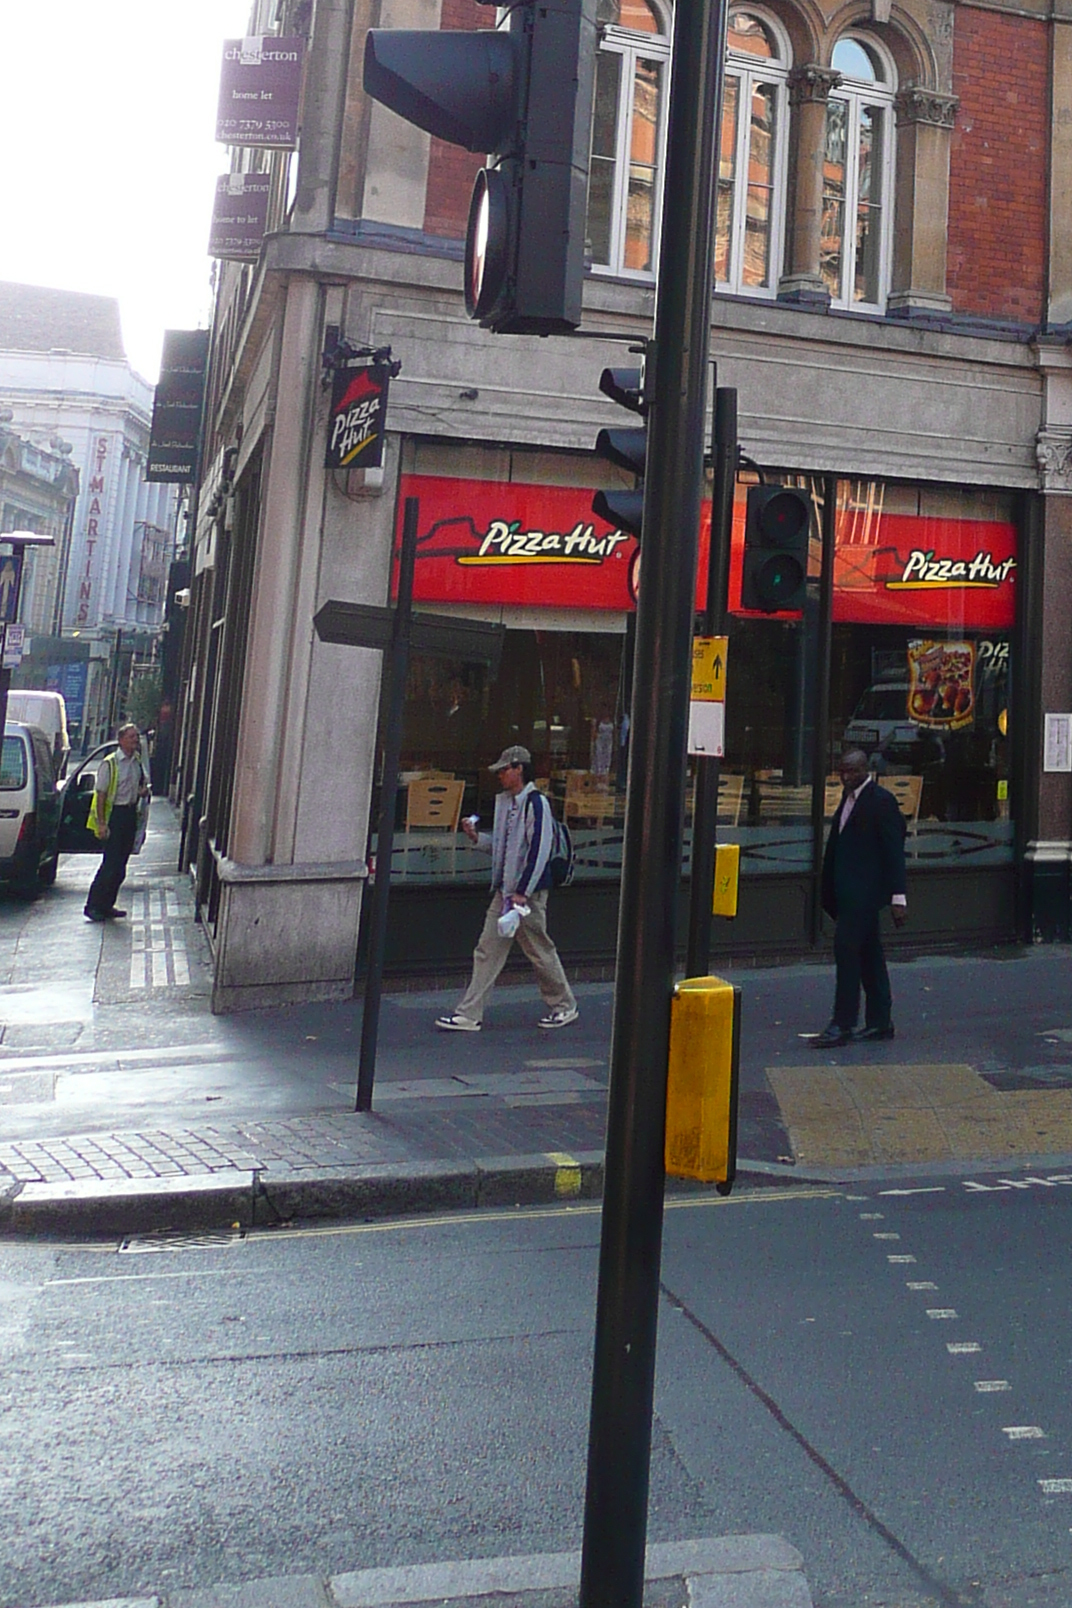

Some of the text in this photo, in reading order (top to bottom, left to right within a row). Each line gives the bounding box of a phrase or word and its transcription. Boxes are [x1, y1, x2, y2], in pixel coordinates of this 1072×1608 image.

[225, 47, 298, 62] chesterton
[232, 89, 273, 100] home let
[264, 120, 290, 131] 5300
[237, 216, 246, 224] to
[247, 214, 258, 224] let
[331, 398, 380, 451] Pizza
[339, 417, 376, 459] Hut
[149, 463, 192, 474] RESTAURANT
[479, 521, 629, 557] Pizza Hut
[902, 550, 1018, 582] Pizza Hut
